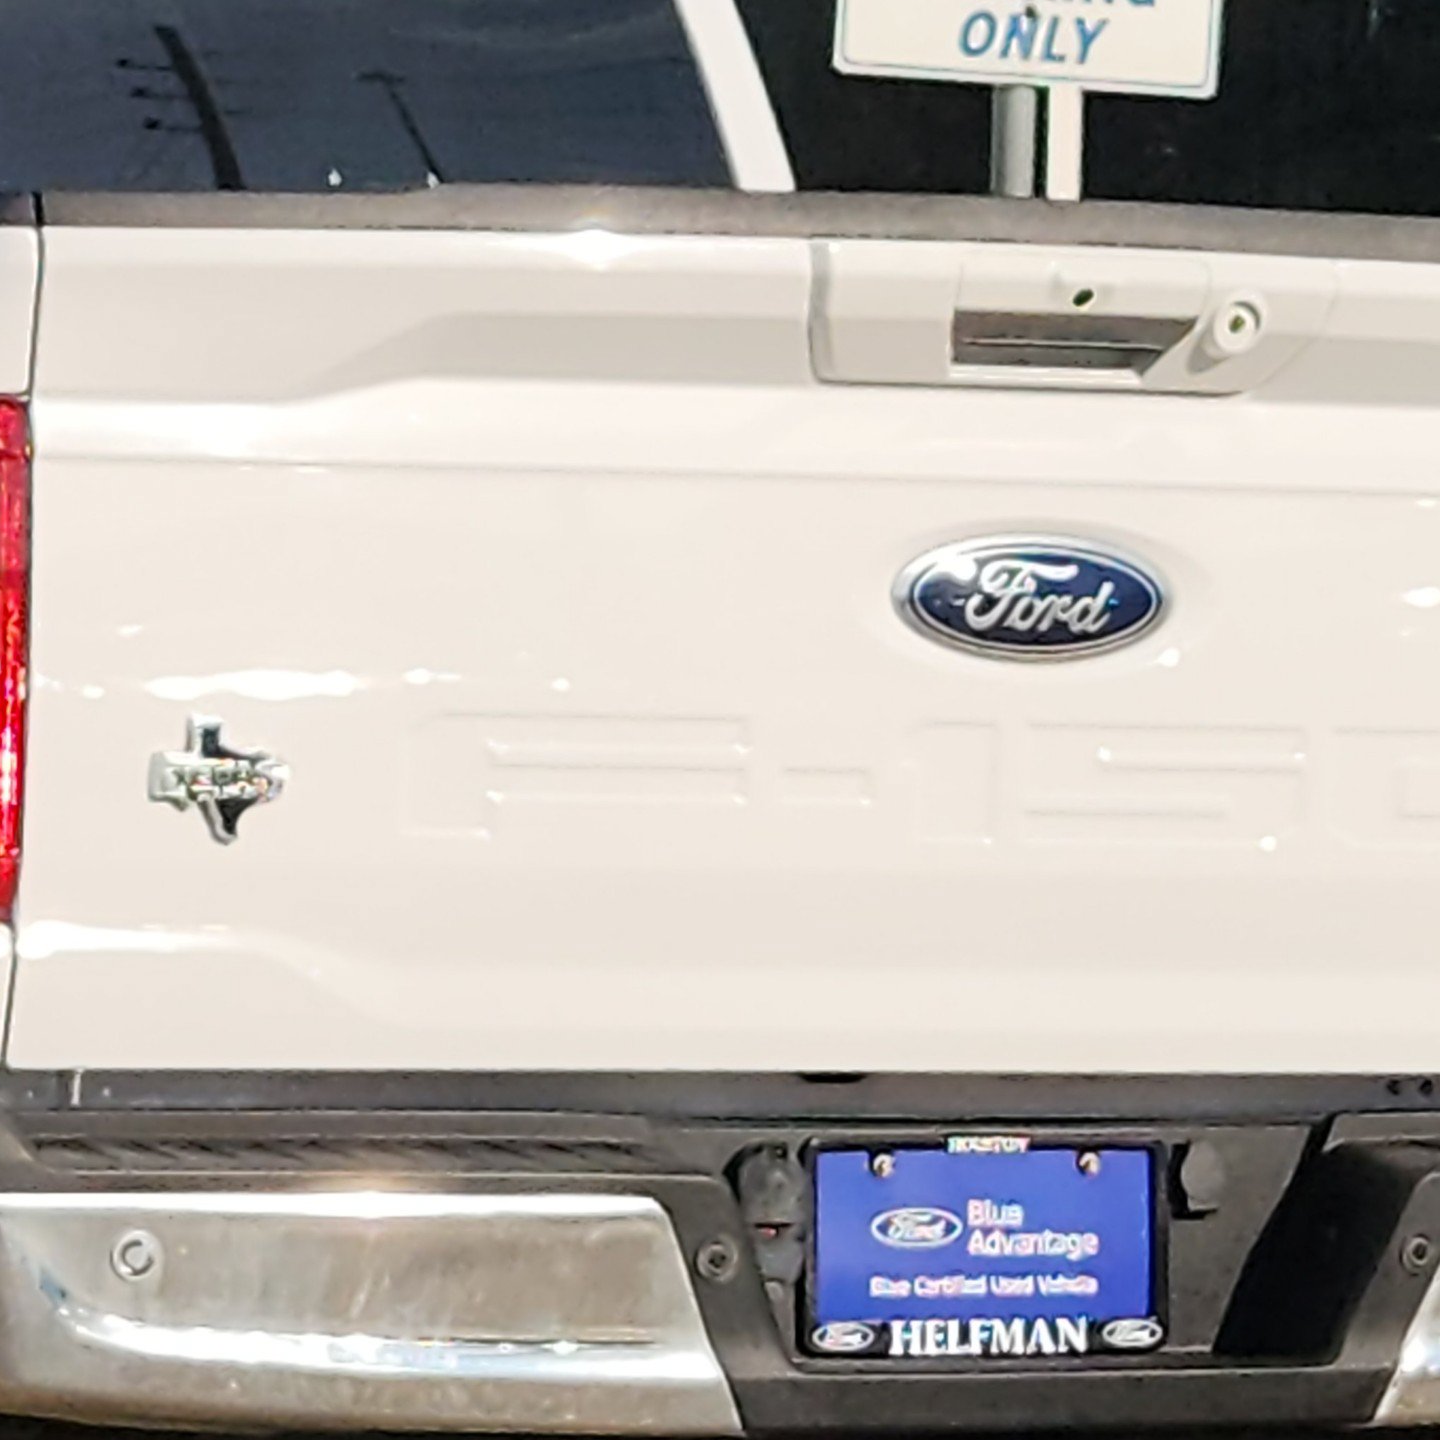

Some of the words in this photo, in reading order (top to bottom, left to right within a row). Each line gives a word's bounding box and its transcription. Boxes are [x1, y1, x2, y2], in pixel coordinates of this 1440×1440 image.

[958, 10, 1110, 65] ONLY
[964, 558, 1116, 634] Ford
[967, 1199, 1024, 1228] Blue
[967, 1228, 1100, 1261] Advantage
[888, 1317, 1090, 1357] HELFMAN
